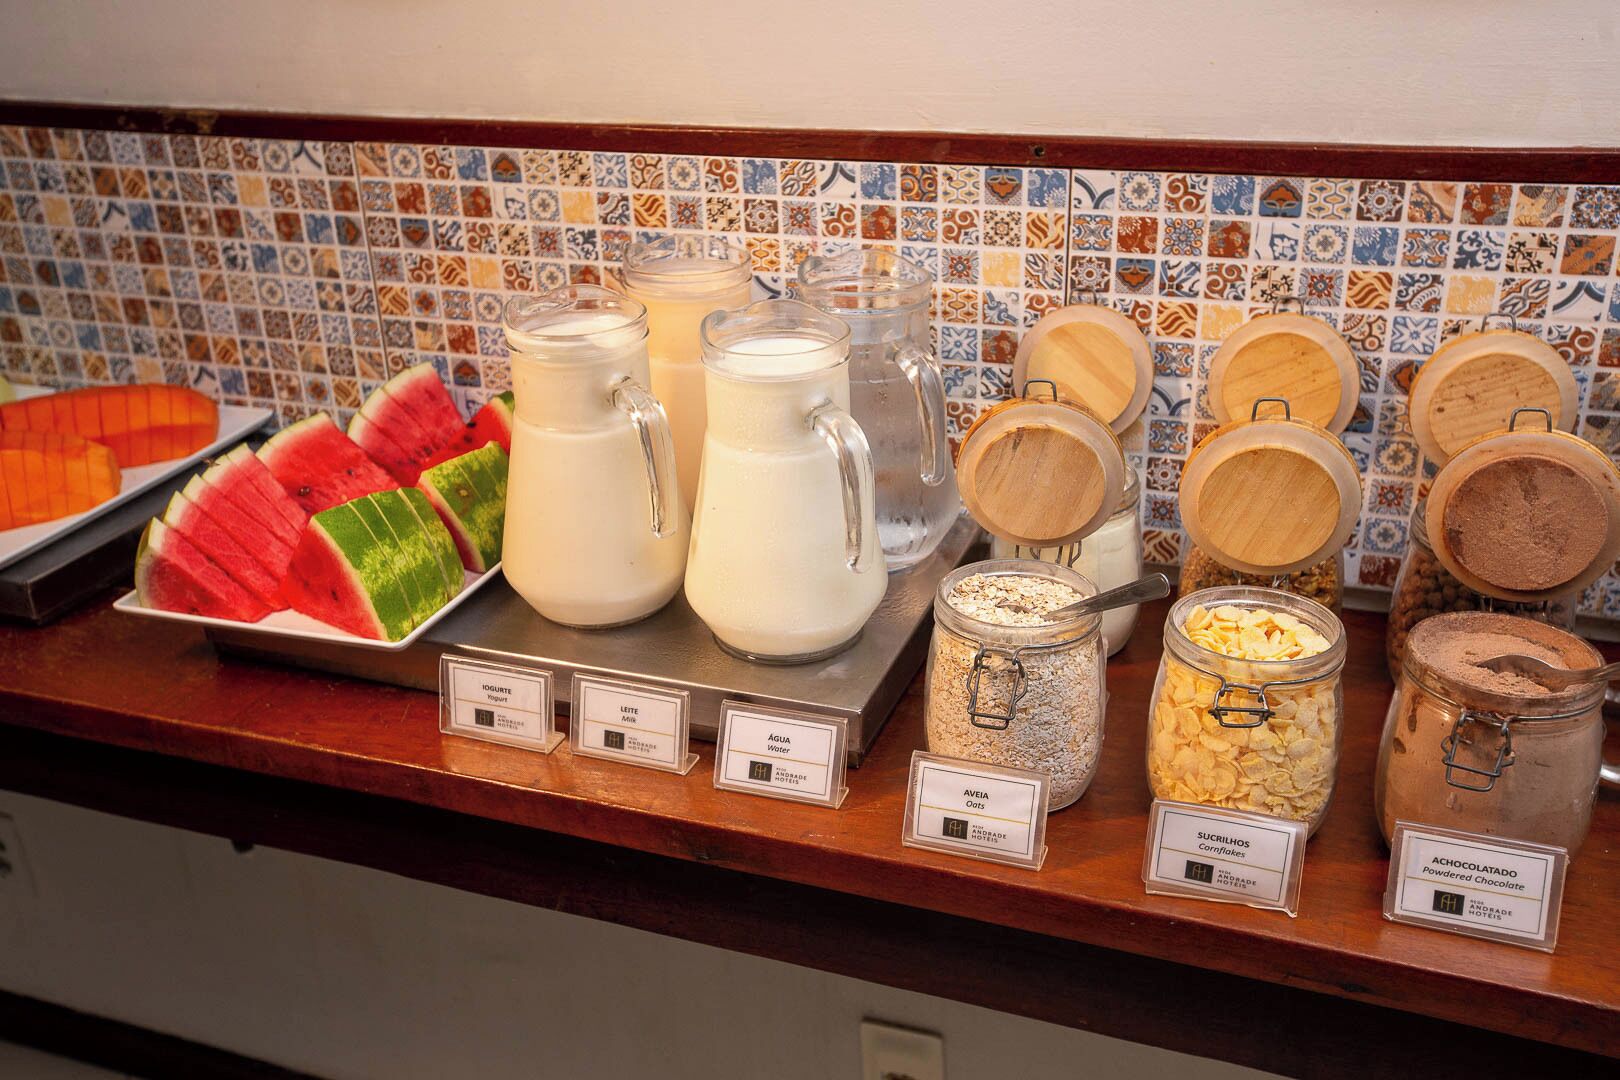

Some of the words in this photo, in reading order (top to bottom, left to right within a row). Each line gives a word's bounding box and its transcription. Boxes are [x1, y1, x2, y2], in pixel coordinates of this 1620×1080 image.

[482, 684, 512, 695] IOGURTE
[487, 694, 508, 703] Yogurt
[620, 706, 639, 715] LEITE
[621, 715, 637, 724] Milk
[768, 732, 791, 745] ÁGUA
[767, 744, 791, 754] Water
[775, 771, 808, 781] ANDRADE
[963, 789, 989, 800] AVEIA
[966, 800, 985, 810] Oats
[972, 829, 1007, 839] ANDRADE
[1197, 831, 1250, 848] SUCRILHOS
[1198, 842, 1246, 858] Cornflakes
[1432, 856, 1518, 878] ACHOCOLATADO
[1217, 873, 1257, 886] ANDRADE
[1422, 866, 1473, 882] Powdered
[1474, 875, 1526, 891] Chocolate
[1469, 904, 1513, 917] ANDRADE
